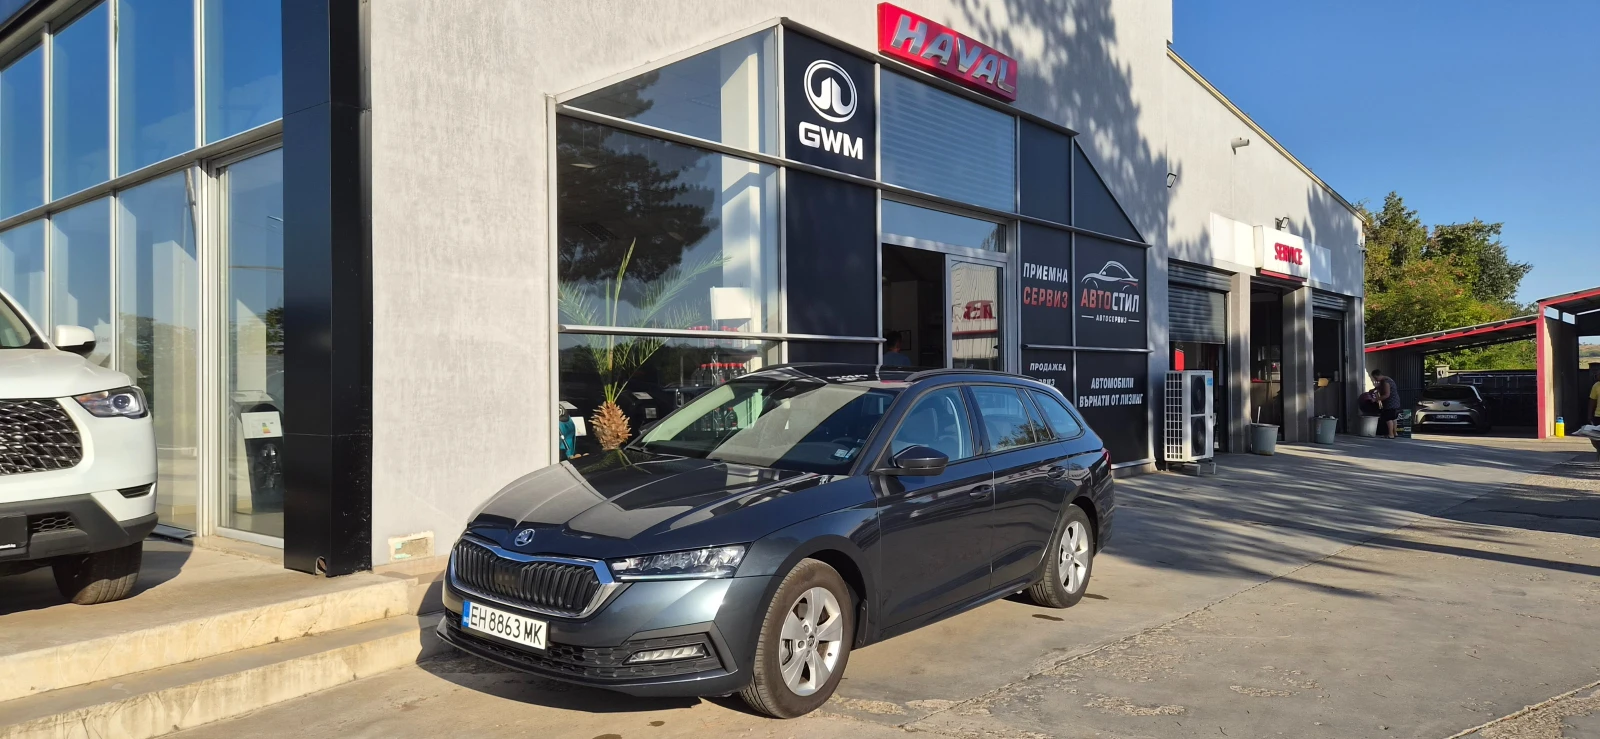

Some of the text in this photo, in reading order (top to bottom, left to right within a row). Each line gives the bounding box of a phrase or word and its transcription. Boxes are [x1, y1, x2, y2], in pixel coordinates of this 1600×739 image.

[890, 14, 1016, 94] HAVAL
[798, 121, 864, 160] GWM
[1274, 242, 1303, 266] SERVICE
[1023, 262, 1068, 283] ПРИЕМНА
[1023, 286, 1068, 309] СЕРВИЗ
[1080, 288, 1140, 313] АВТОСТИЛ
[1095, 314, 1127, 324] АВТОСЕРВИЗ
[1029, 362, 1067, 372] ПРОДАЖБА
[1090, 377, 1134, 389] АВТОМОБИЛИ
[1079, 393, 1144, 407] ВЪРНАТИ ОТ ЛИЗИНГ
[471, 606, 542, 645] EH 8863 MK
